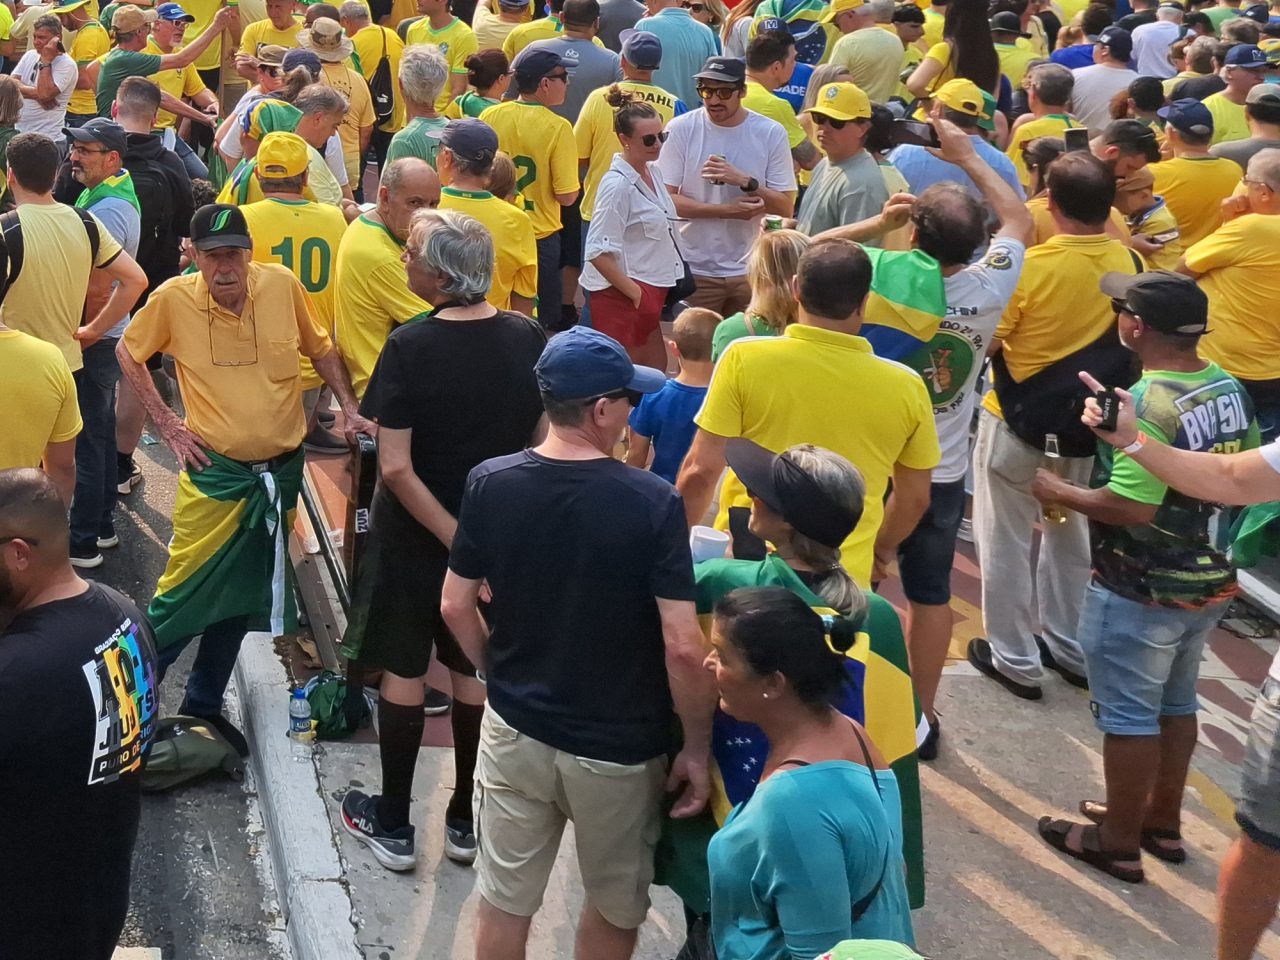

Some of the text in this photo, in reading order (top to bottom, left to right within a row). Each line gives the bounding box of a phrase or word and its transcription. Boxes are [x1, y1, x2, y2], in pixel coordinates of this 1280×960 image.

[271, 236, 331, 292] 10
[1179, 391, 1249, 451] BRASIL
[351, 816, 375, 835] FILA
